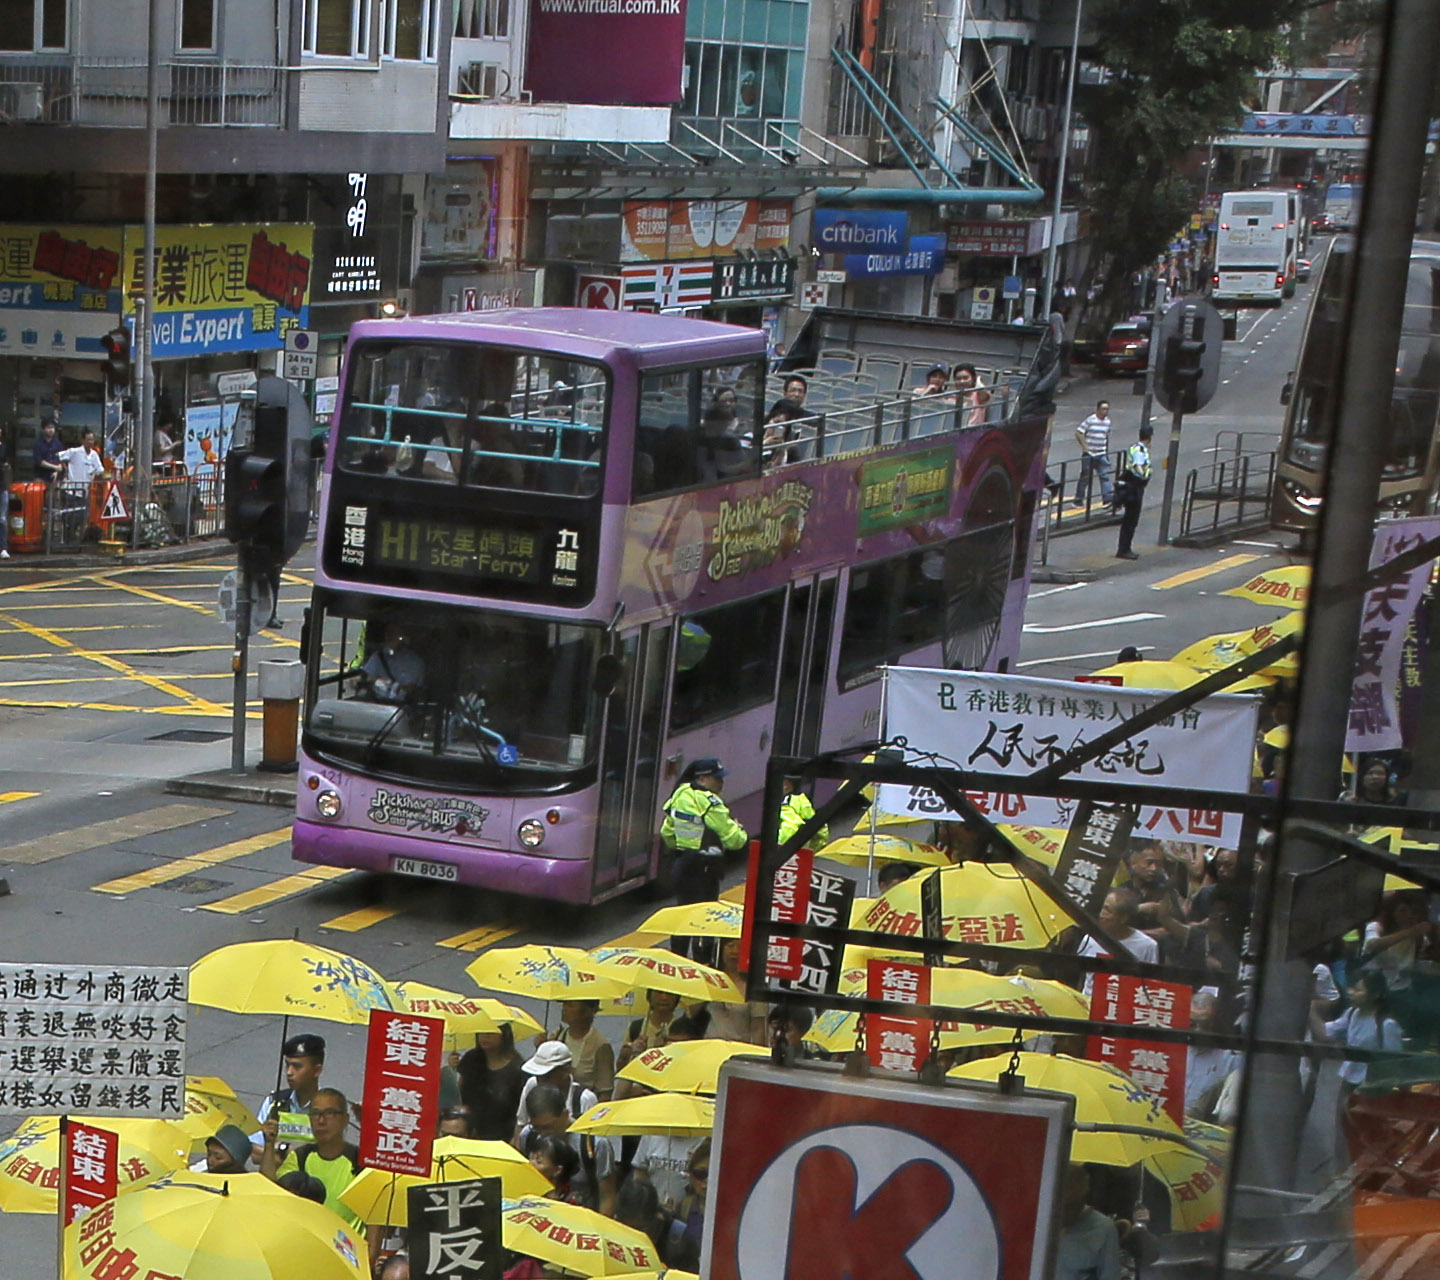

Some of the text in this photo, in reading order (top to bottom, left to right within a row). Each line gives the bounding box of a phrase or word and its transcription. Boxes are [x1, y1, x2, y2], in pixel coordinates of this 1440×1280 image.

[822, 222, 898, 244] citibank
[181, 311, 244, 346] Expert
[288, 354, 313, 364] 24 hrs
[290, 365, 310, 377] 全日
[344, 506, 367, 548] 香港
[765, 515, 781, 548] BUS
[381, 521, 419, 560] H1
[555, 529, 578, 570] 九龍
[342, 547, 364, 557] Hong
[342, 555, 364, 566] Kong
[431, 550, 529, 576] Star Ferry
[371, 789, 427, 808] Rickshaw
[432, 811, 456, 826] BUS
[397, 859, 454, 878] KN 8036
[378, 1019, 430, 1156] 結束一黨專政
